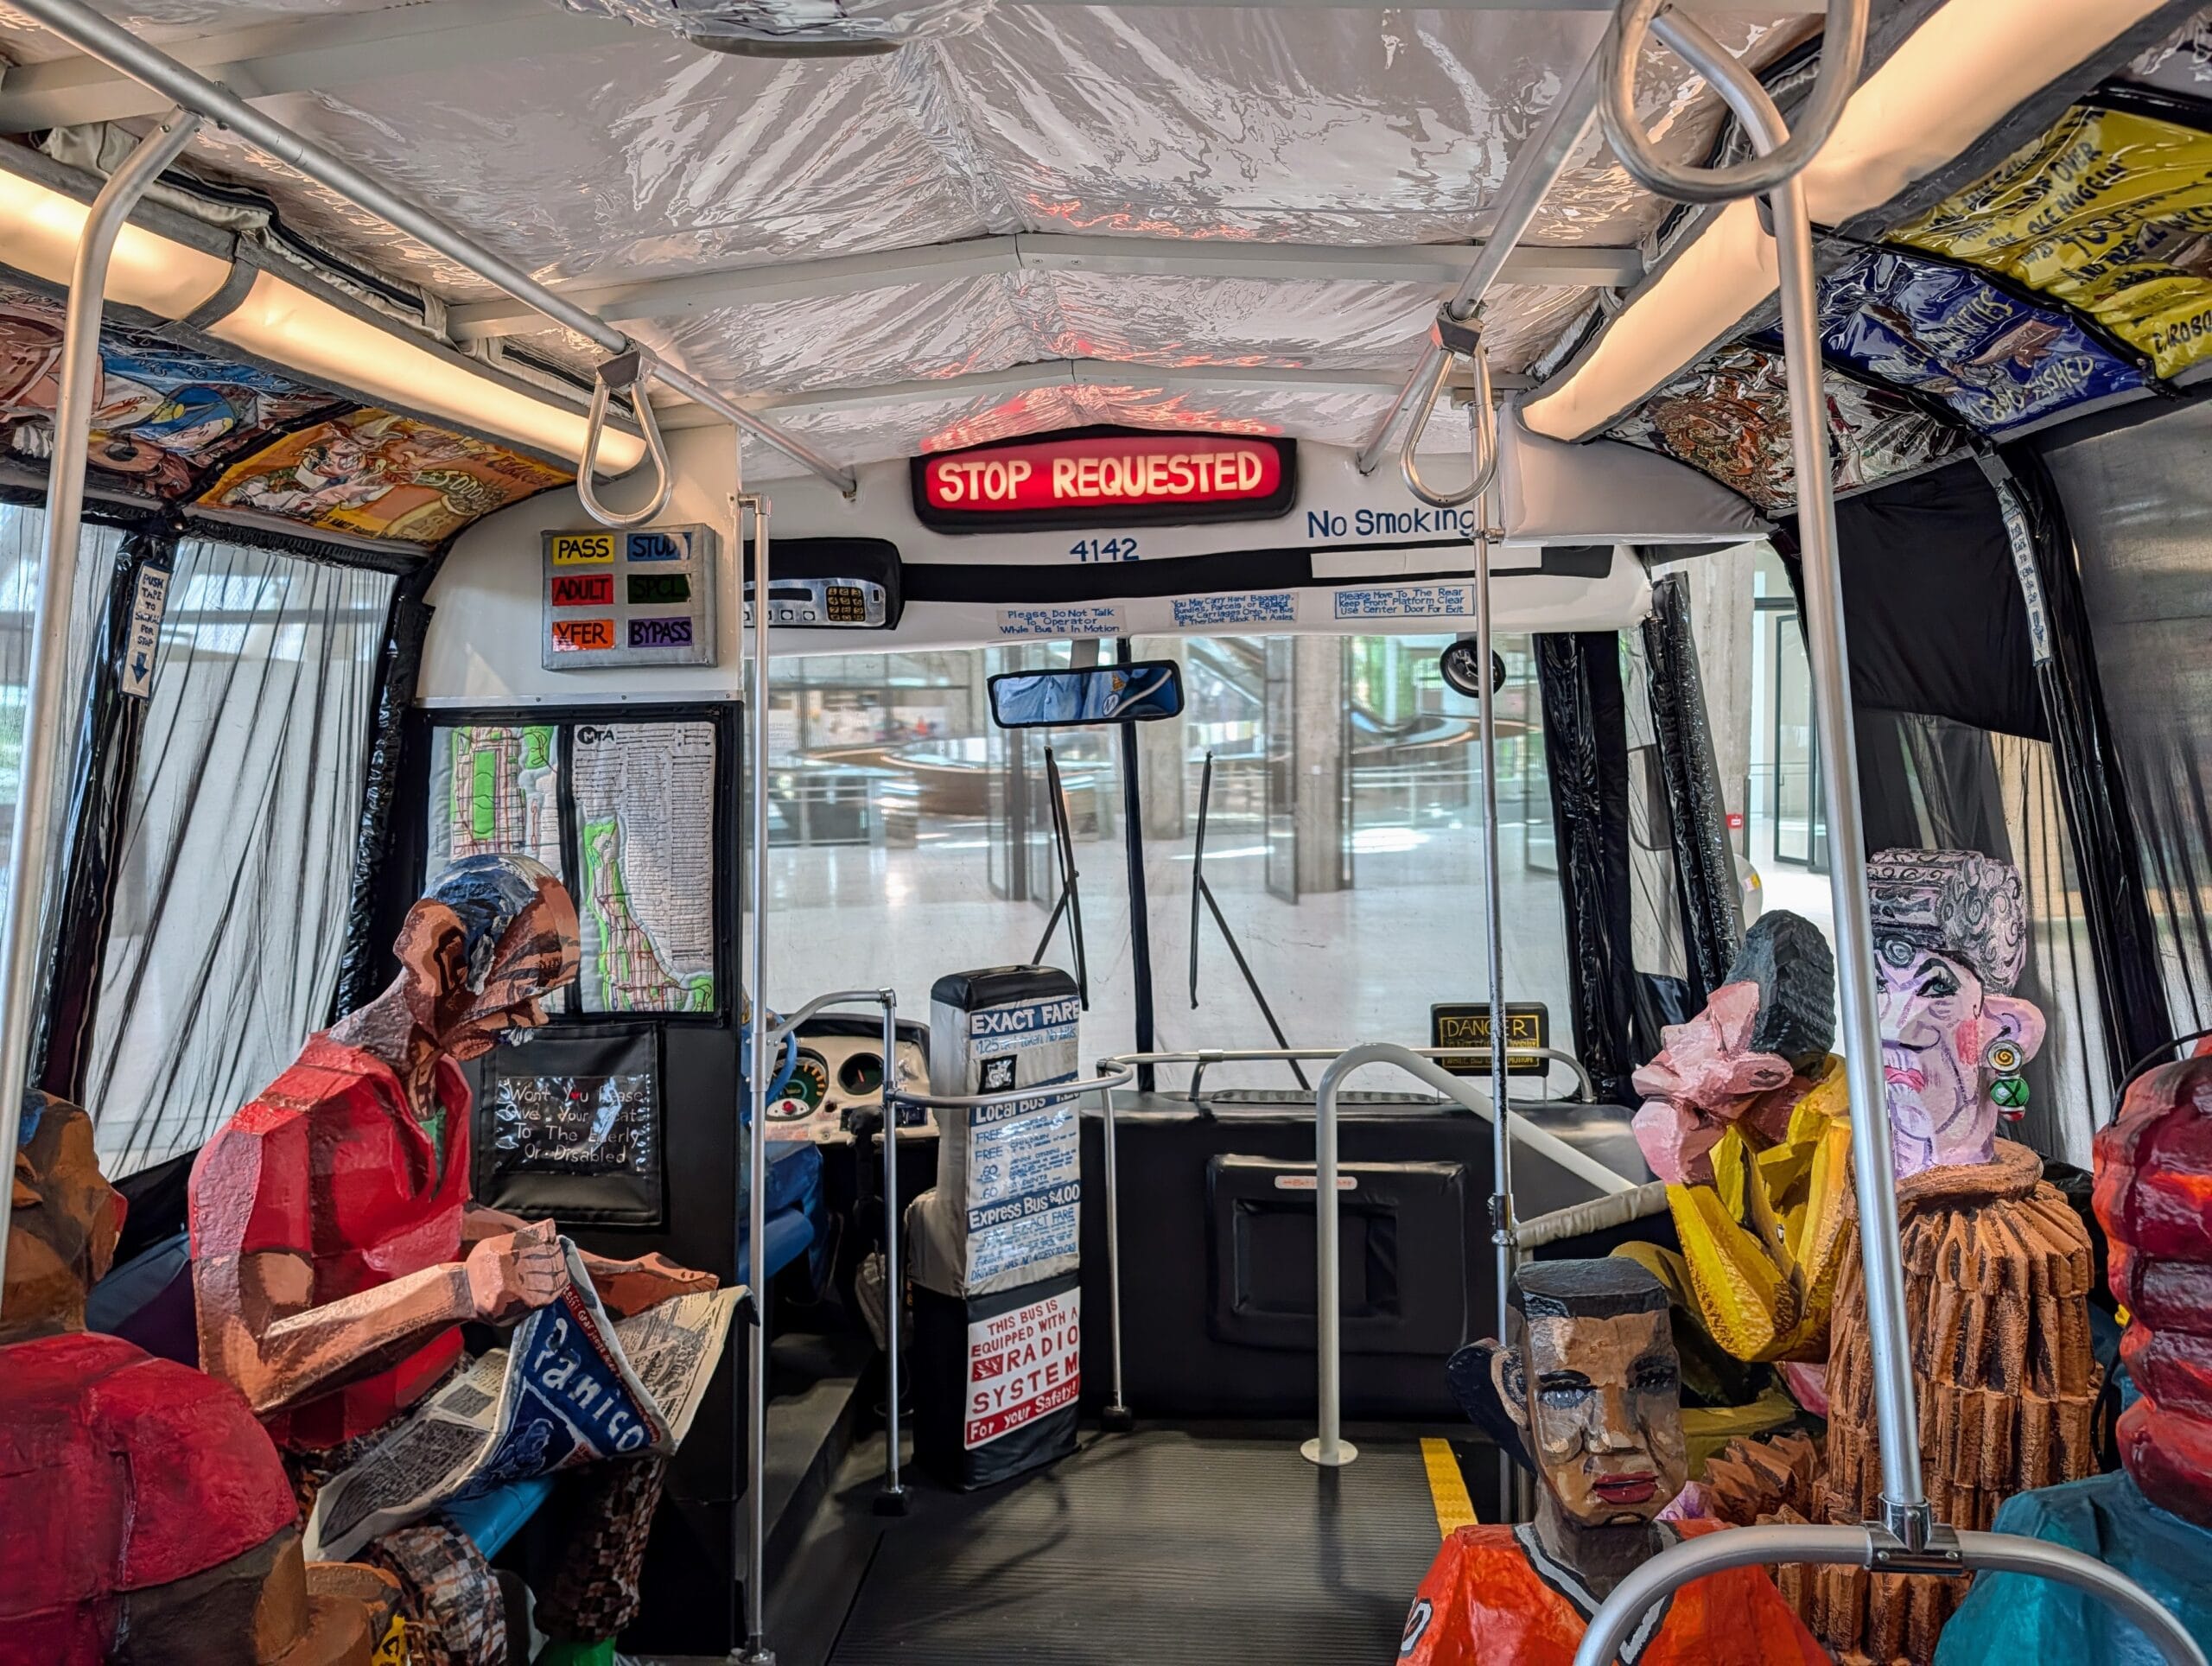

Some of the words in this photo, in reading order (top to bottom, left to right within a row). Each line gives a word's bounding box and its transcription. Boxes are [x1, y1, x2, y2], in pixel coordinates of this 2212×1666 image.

[938, 460, 1033, 503] STOP
[1052, 450, 1264, 499] REQUESTED
[1307, 510, 1347, 538] No
[1354, 508, 1475, 537] Smoking
[557, 537, 610, 560] PASS
[1070, 537, 1140, 563] 4142
[143, 574, 164, 589] PUSH
[554, 578, 610, 603] ADULT
[141, 588, 162, 601] TAPE
[1171, 600, 1187, 609] You
[1188, 598, 1205, 607] May
[1338, 592, 1371, 601] Please
[1373, 591, 1394, 600] Move
[1438, 588, 1464, 596] Rear
[1339, 600, 1361, 608] Keep
[1363, 599, 1389, 607] Front
[1392, 596, 1435, 606] Platform
[1437, 596, 1465, 605] Clear
[145, 601, 156, 611] TO
[1007, 610, 1047, 620] Please
[1052, 609, 1066, 619] Do
[1067, 608, 1088, 618] Not
[1091, 608, 1115, 617] Talk
[1340, 607, 1359, 615] Use
[1363, 606, 1398, 614] Center
[1404, 605, 1426, 614] Door
[1427, 604, 1441, 614] For
[1446, 605, 1465, 614] Exit
[140, 624, 154, 636] FOR
[1000, 625, 1029, 634] While
[1034, 625, 1052, 633] Bus
[1084, 624, 1121, 633] Motion
[1024, 617, 1037, 626] To
[1043, 616, 1098, 627] Operator
[137, 635, 154, 647] STOP
[630, 620, 691, 646] BYPASS
[971, 1008, 1036, 1035] EXACT
[1041, 1000, 1080, 1026] FARE
[559, 1105, 589, 1122] Your
[514, 1122, 532, 1139] To
[545, 1124, 578, 1141] The
[524, 1143, 540, 1160] Or
[553, 1145, 627, 1164] Disabled
[975, 1146, 1003, 1163] FREE
[1049, 1183, 1081, 1205] $4.00
[1052, 1206, 1075, 1224] FARE
[987, 1316, 1016, 1336] THIS
[1020, 1305, 1044, 1325] BUS
[1046, 1299, 1058, 1313] IS
[970, 1326, 1035, 1358] EQUIPPED
[1038, 1311, 1066, 1333] WITH
[1071, 1307, 1078, 1320] A
[1007, 1325, 1079, 1372] RADIO
[971, 1351, 1078, 1415] SYSTEM
[970, 1421, 995, 1440] For
[1035, 1380, 1077, 1413] Safety!
